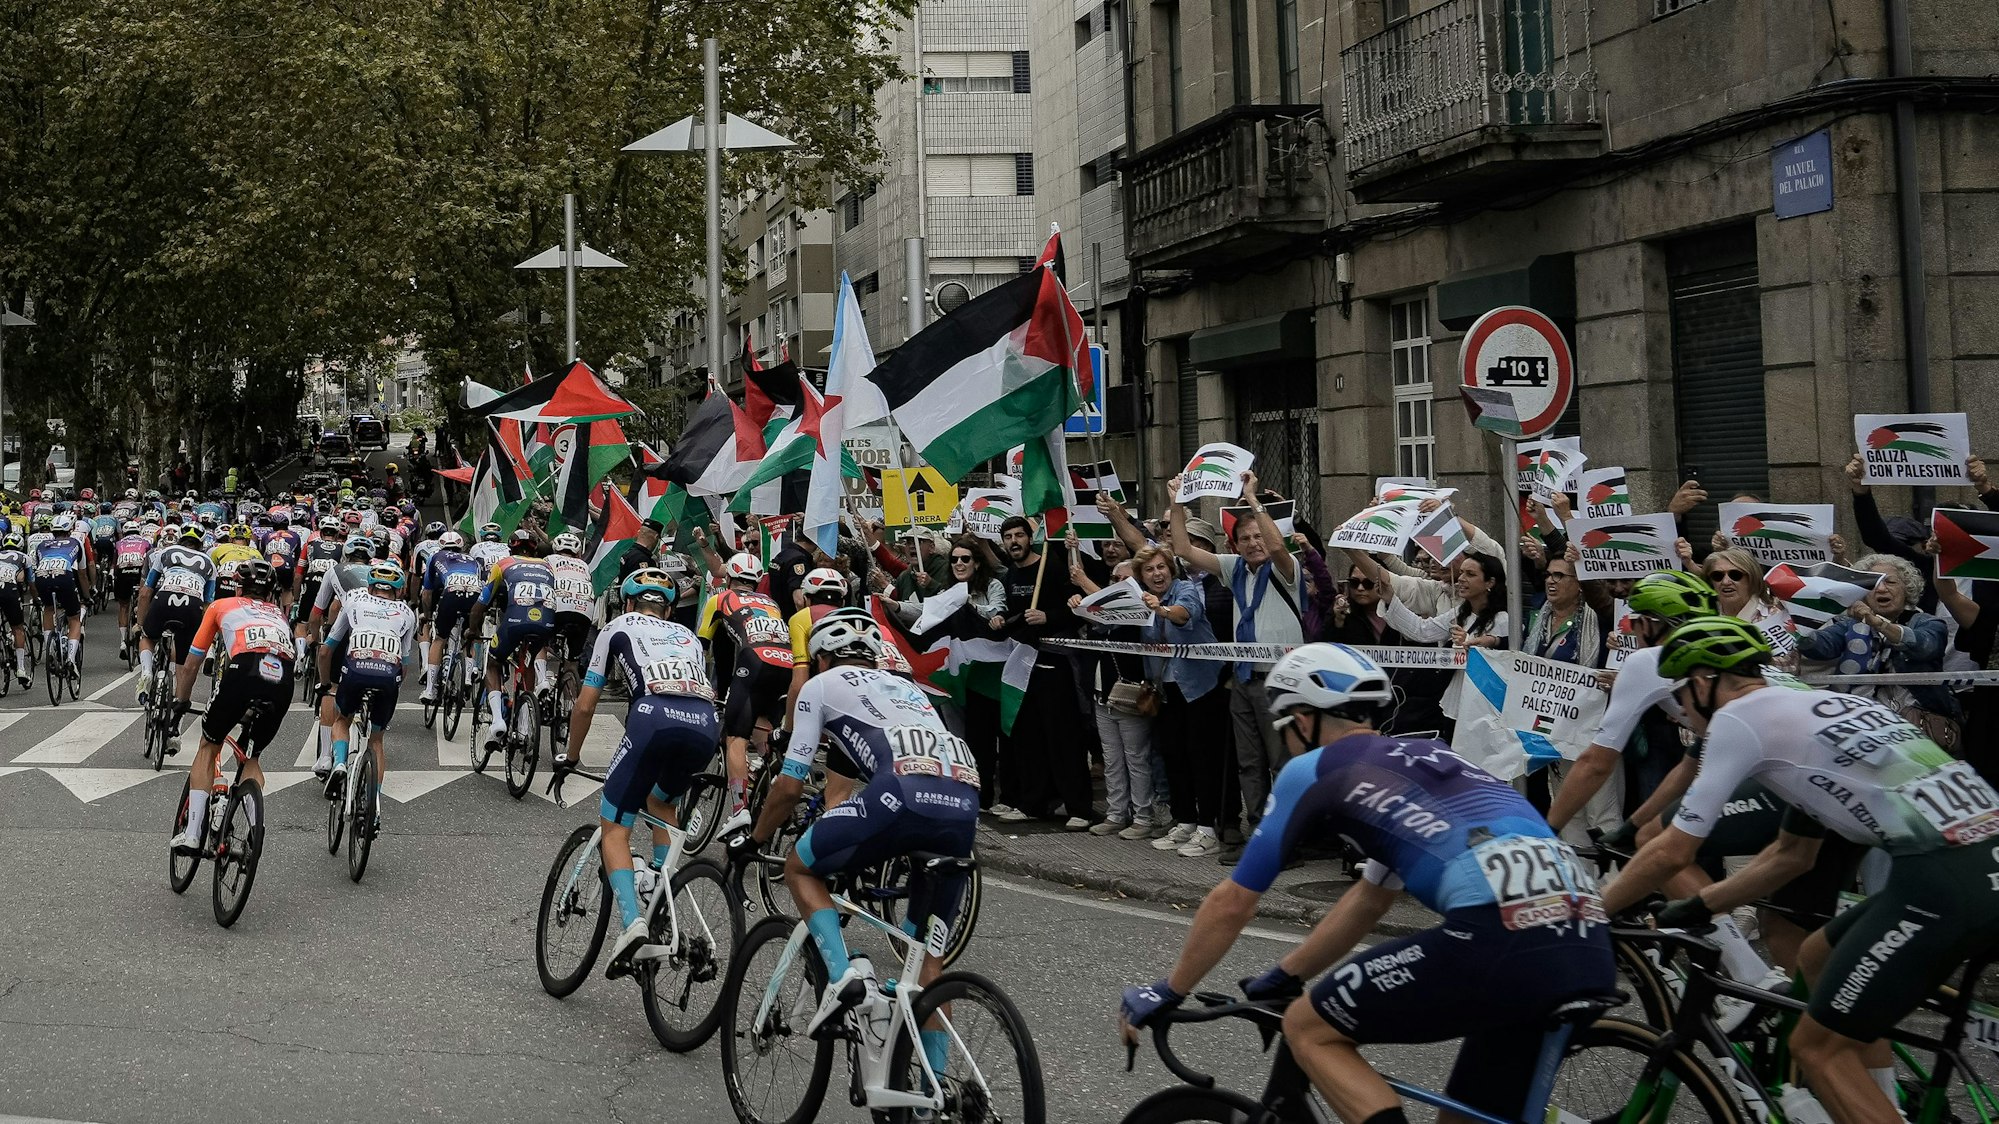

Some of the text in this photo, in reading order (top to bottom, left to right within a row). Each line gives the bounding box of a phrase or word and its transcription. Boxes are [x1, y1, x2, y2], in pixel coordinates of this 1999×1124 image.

[1785, 160, 1816, 177] MANUEL
[1780, 174, 1824, 195] DEL PALACIO
[1510, 360, 1545, 378] 10 t
[857, 439, 871, 448] ES
[850, 449, 891, 464] JOR
[1866, 450, 1908, 463] GALIZA
[1183, 471, 1203, 484] GALIZA
[1869, 464, 1961, 478] CON PALESTINA
[1183, 480, 1233, 496] CON PALESTINA
[968, 512, 990, 521] GALIZA
[1587, 503, 1624, 519] GALIZA
[1337, 530, 1398, 548] CON PALESTINA
[1731, 537, 1773, 549] GALIZA
[1581, 549, 1621, 561] GALIZA
[1762, 549, 1826, 562] PALESTINA
[1584, 558, 1672, 572] CON PALESTINA
[169, 575, 181, 585] 36
[188, 578, 200, 591] 36
[555, 580, 572, 591] 187
[520, 584, 533, 598] 24
[247, 627, 267, 641] 64
[352, 633, 377, 650] 107
[1201, 645, 1233, 657] NACIONAL
[1234, 645, 1244, 657] DE
[1244, 646, 1272, 659] POLICIA
[1363, 649, 1465, 665] CIONAL DE POLICIA NO
[1616, 650, 1632, 662] CO
[646, 661, 683, 682] 103
[687, 661, 711, 687] 10
[1513, 659, 1602, 691] SOLIDARIEDAD
[1531, 680, 1576, 701] CO POBO
[663, 706, 700, 720] BAHRAIN
[1521, 695, 1579, 720] PALESTINO
[893, 728, 939, 759] 102
[947, 737, 975, 768] 10
[914, 791, 961, 803] BAHRAIN
[1808, 774, 1854, 806] CAJA
[1913, 771, 1992, 826] 146
[1343, 781, 1451, 838] FACTOR
[1722, 798, 1763, 817] RGA
[690, 816, 703, 834] 103
[1486, 844, 1565, 902] 225
[930, 924, 945, 952] 102
[1364, 944, 1426, 977] PREMIER
[1830, 919, 1925, 1014] SEGUROS RGA
[1370, 967, 1416, 993] TECH
